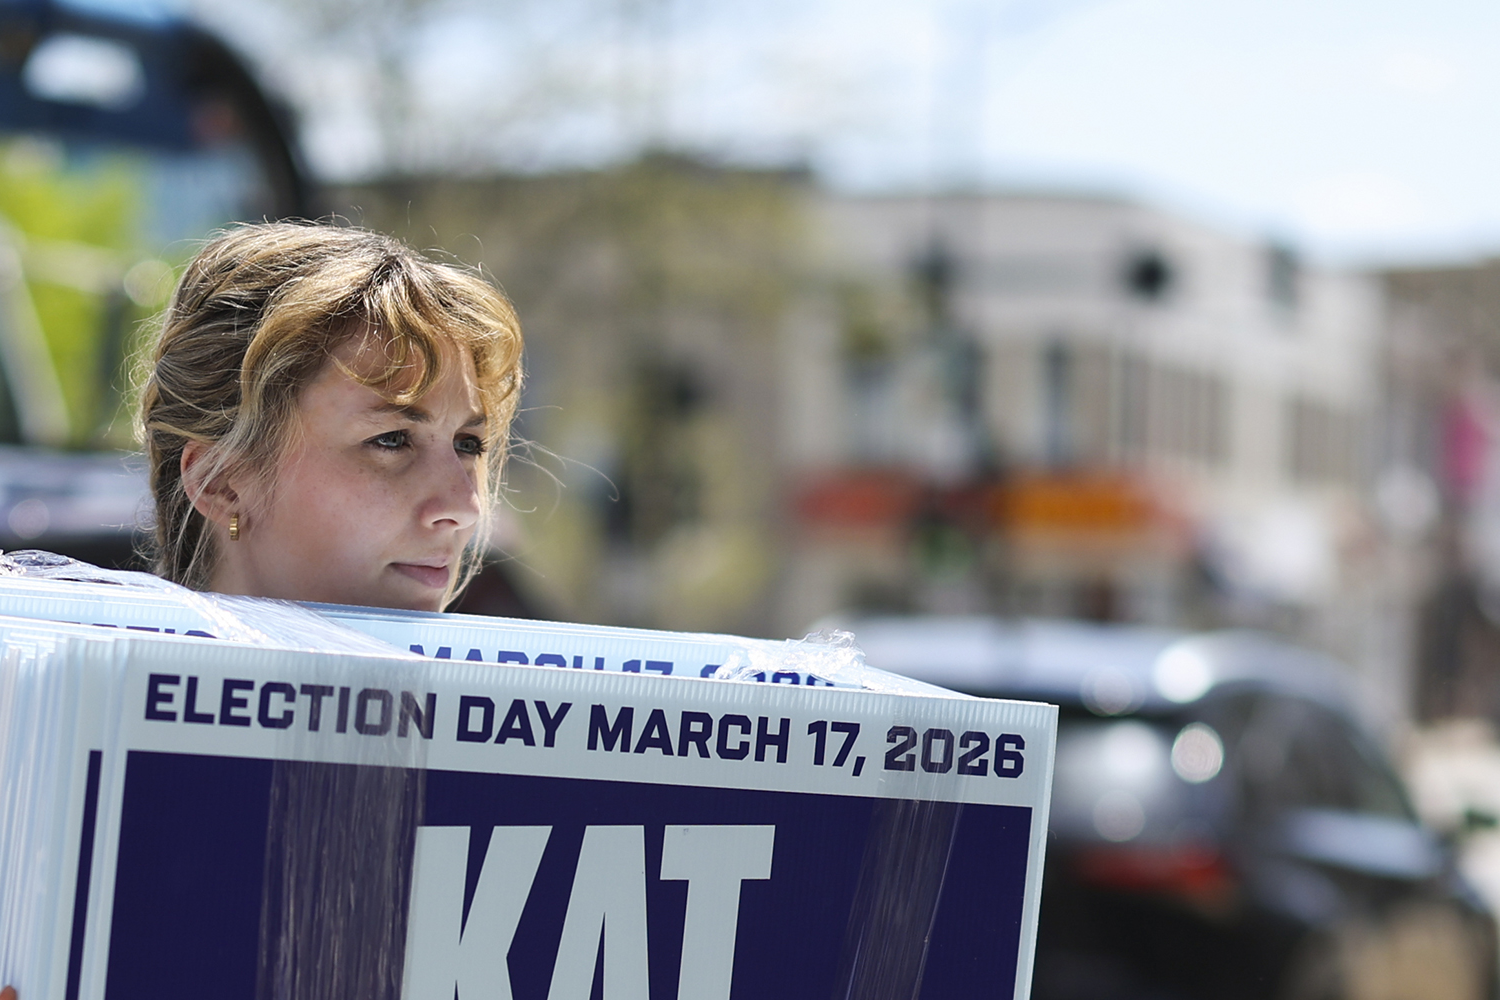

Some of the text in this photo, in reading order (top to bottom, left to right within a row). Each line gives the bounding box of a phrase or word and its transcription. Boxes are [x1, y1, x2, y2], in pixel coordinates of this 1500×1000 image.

[145, 673, 1027, 780] ELECTION DAY MARCH 17, 2026
